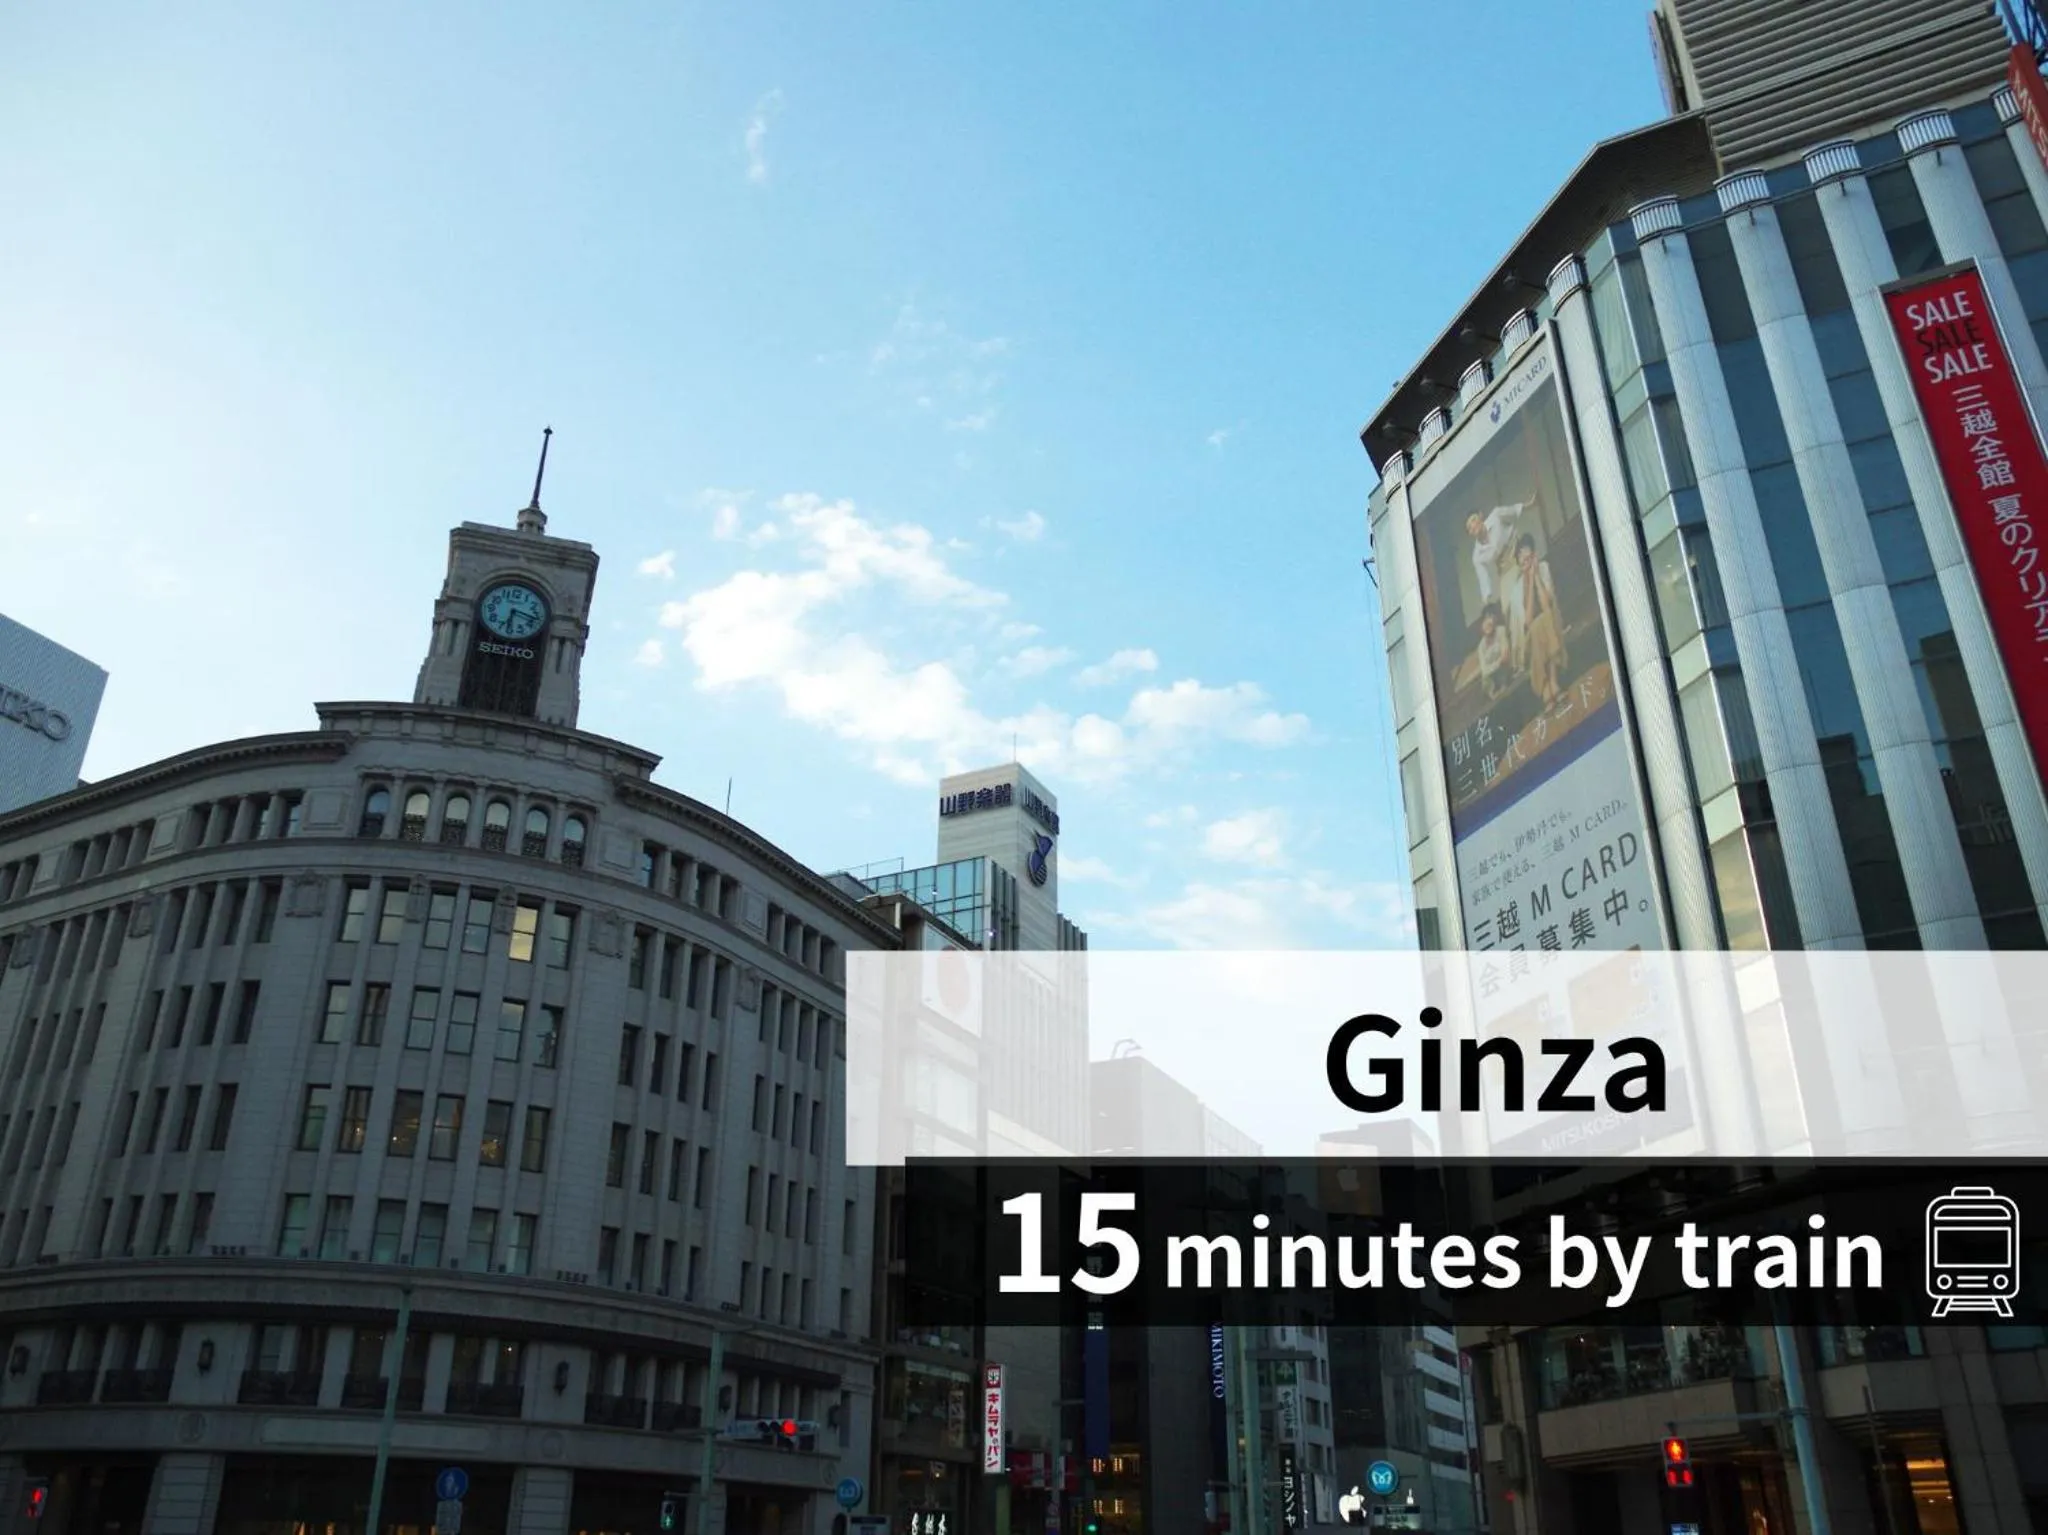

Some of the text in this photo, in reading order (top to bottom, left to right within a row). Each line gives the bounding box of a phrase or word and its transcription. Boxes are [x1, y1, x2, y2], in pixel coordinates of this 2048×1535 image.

[1906, 290, 1973, 330] SALE
[1917, 317, 1984, 356] SALE
[1924, 343, 1994, 384] SALE
[1952, 384, 2048, 662] 三越全館 夏のクリア
[479, 641, 535, 660] SEIKO
[1473, 832, 1638, 952] 三越 M CARD
[1210, 1321, 1225, 1399] MIKIMOTO
[987, 1392, 1000, 1469] キムラヤのパン
